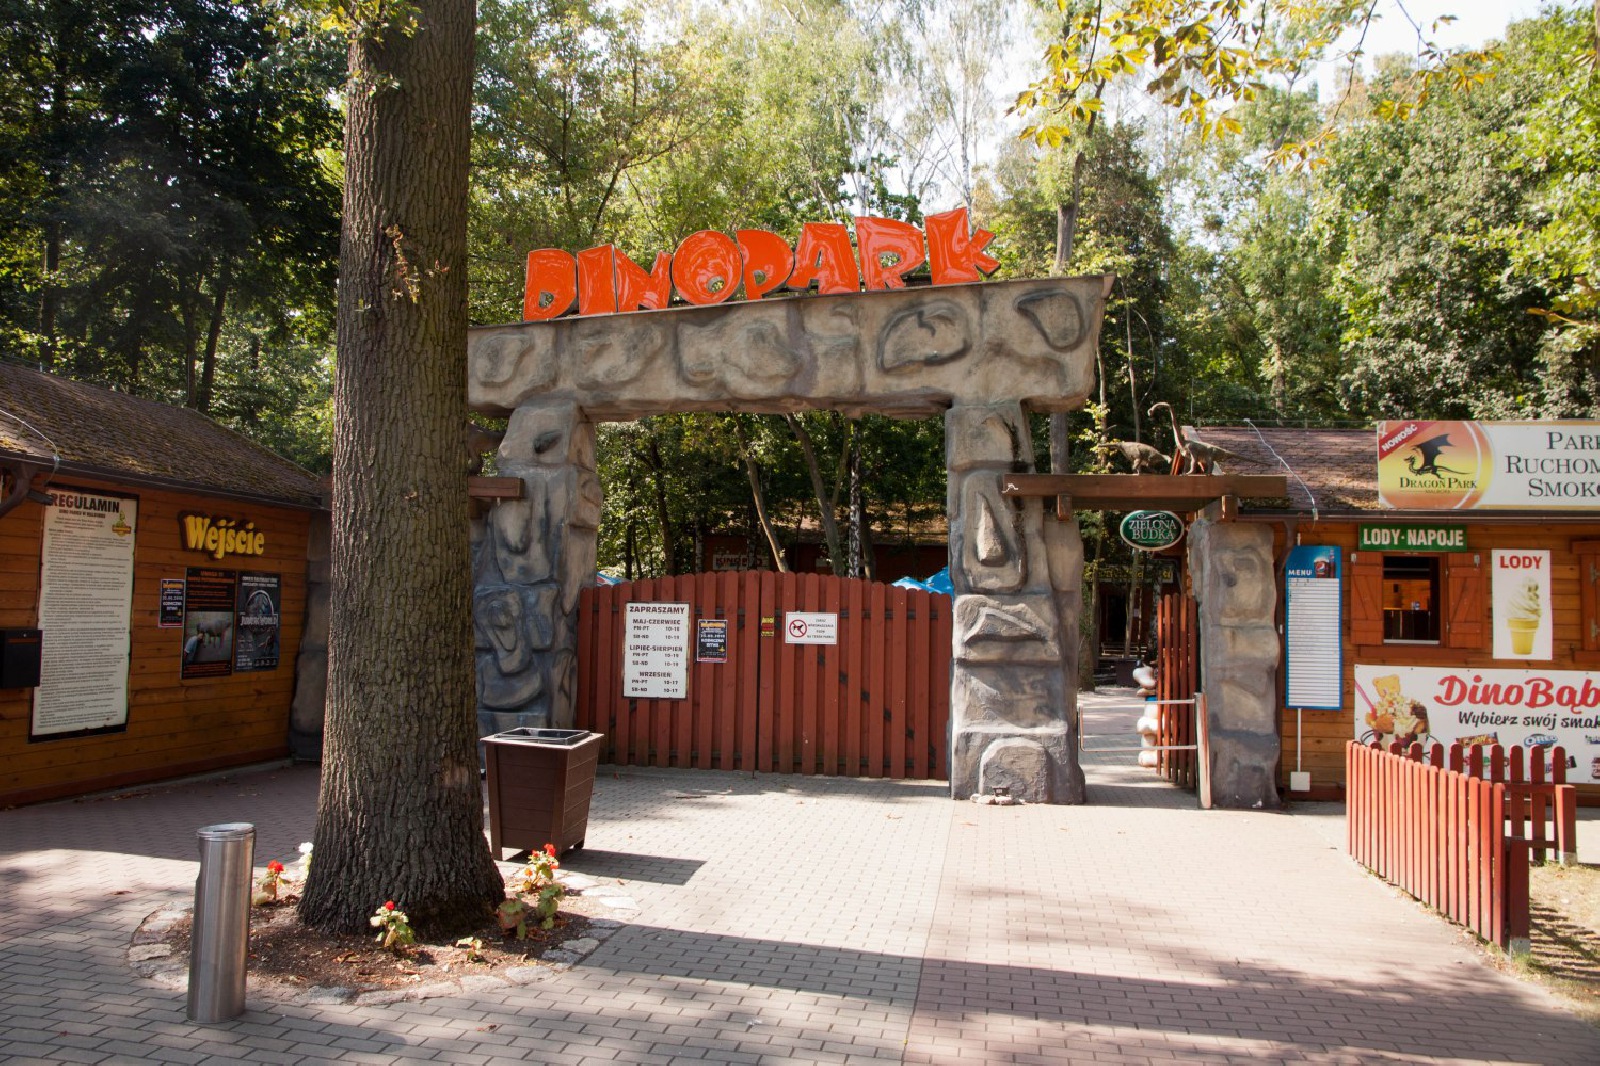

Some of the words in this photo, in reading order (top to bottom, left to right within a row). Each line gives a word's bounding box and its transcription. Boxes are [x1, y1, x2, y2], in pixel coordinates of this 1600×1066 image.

[523, 207, 1001, 321] DINOPARK
[1381, 423, 1418, 451] NOWOŚĆ
[1400, 477, 1446, 489] DRAGON
[1448, 477, 1477, 489] PARK
[1528, 478, 1600, 497] SMOK
[51, 493, 120, 513] REGULAMIN
[1129, 519, 1177, 530] ZIELONA
[184, 514, 265, 560] Wejście
[1132, 529, 1175, 540] BUDKA
[1363, 528, 1400, 545] LODY
[1407, 529, 1464, 546] NAPOJE
[1499, 555, 1543, 570] LODY
[629, 606, 685, 614] ZAPRASZAMY
[1433, 674, 1600, 714] DinoBąb
[1458, 711, 1518, 728] Wybierz
[1522, 713, 1557, 730] swój
